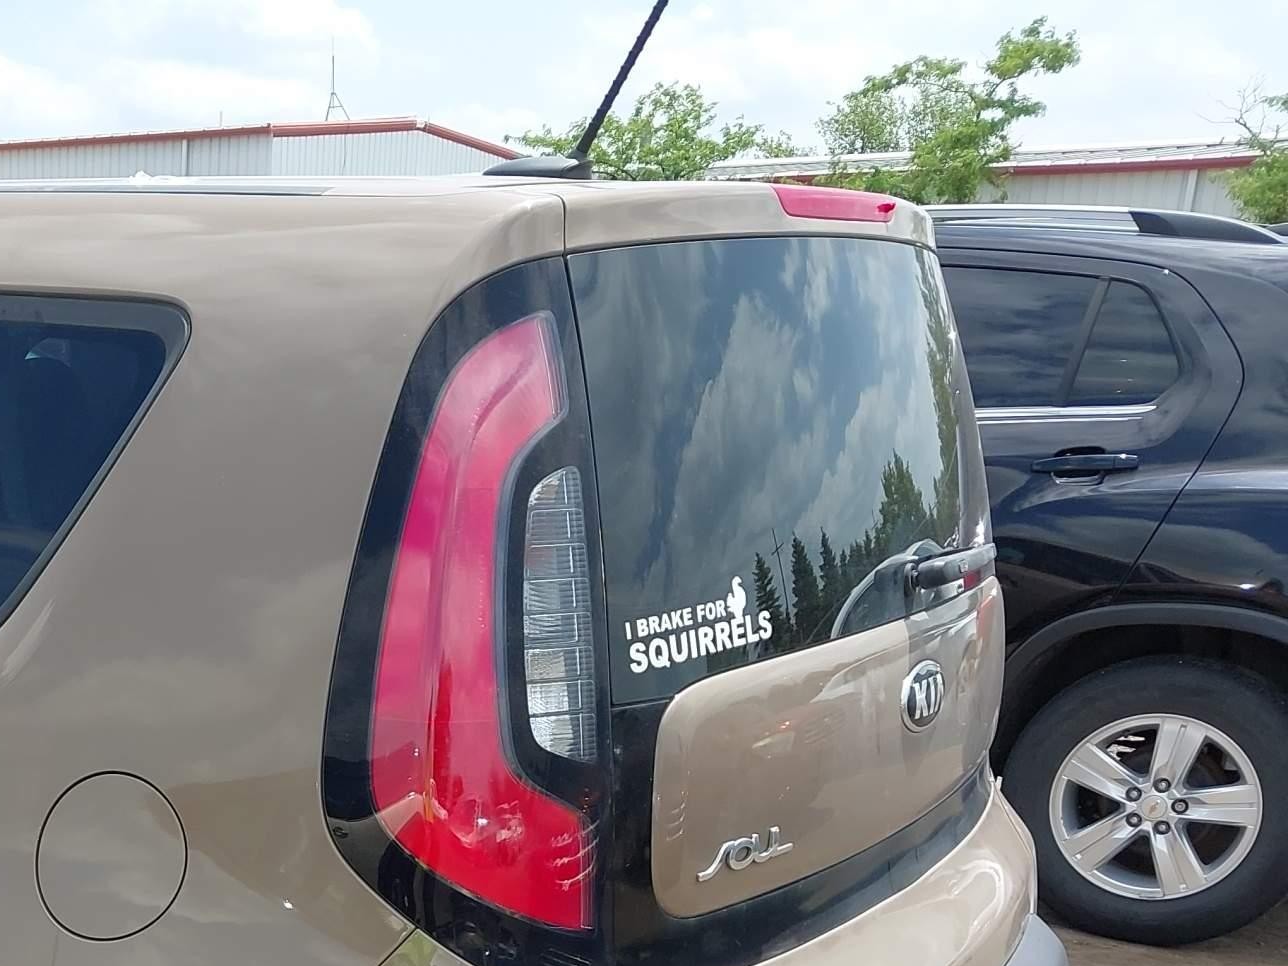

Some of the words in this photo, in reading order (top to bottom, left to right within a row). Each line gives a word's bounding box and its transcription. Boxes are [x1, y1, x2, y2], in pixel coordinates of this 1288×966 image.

[624, 621, 633, 641] I
[636, 607, 694, 638] BRAKE
[696, 599, 728, 623] FOR
[628, 610, 774, 674] SQUIRRELS
[696, 825, 794, 882] SOUL
